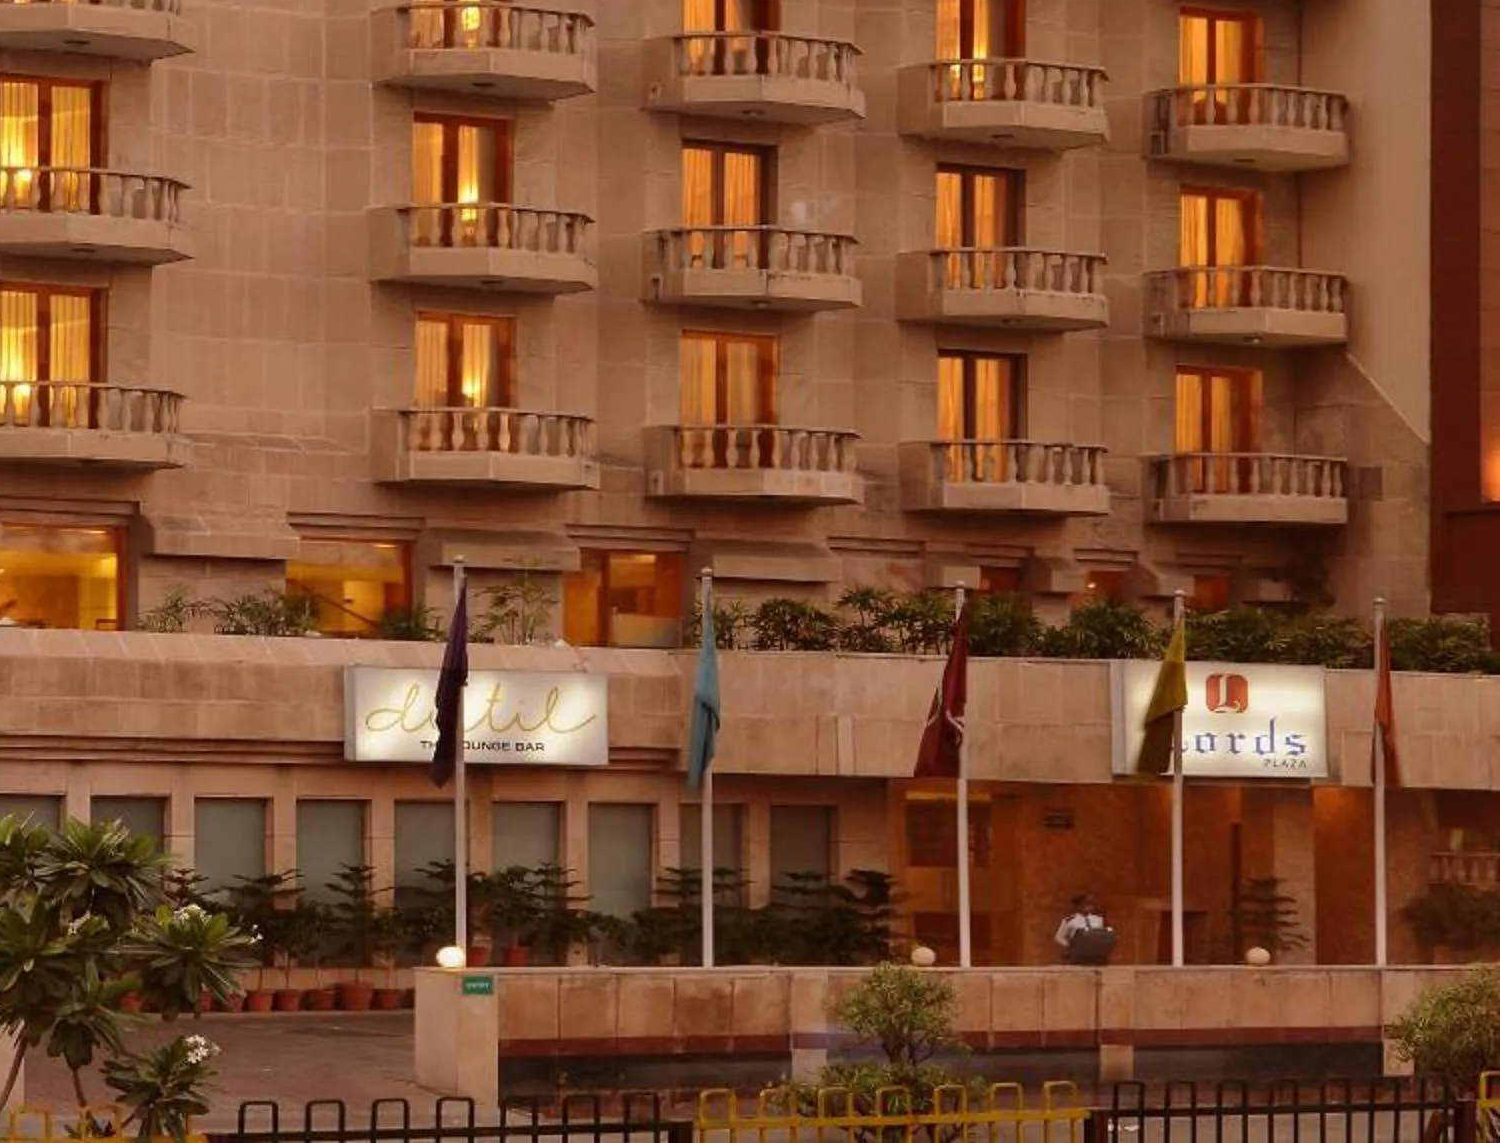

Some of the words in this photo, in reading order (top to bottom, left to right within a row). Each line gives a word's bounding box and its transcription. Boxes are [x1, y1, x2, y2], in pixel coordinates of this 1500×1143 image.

[1181, 717, 1308, 756] ords
[461, 740, 511, 752] OUNGE
[515, 742, 546, 752] BAR
[1263, 758, 1308, 769] PLAZA
